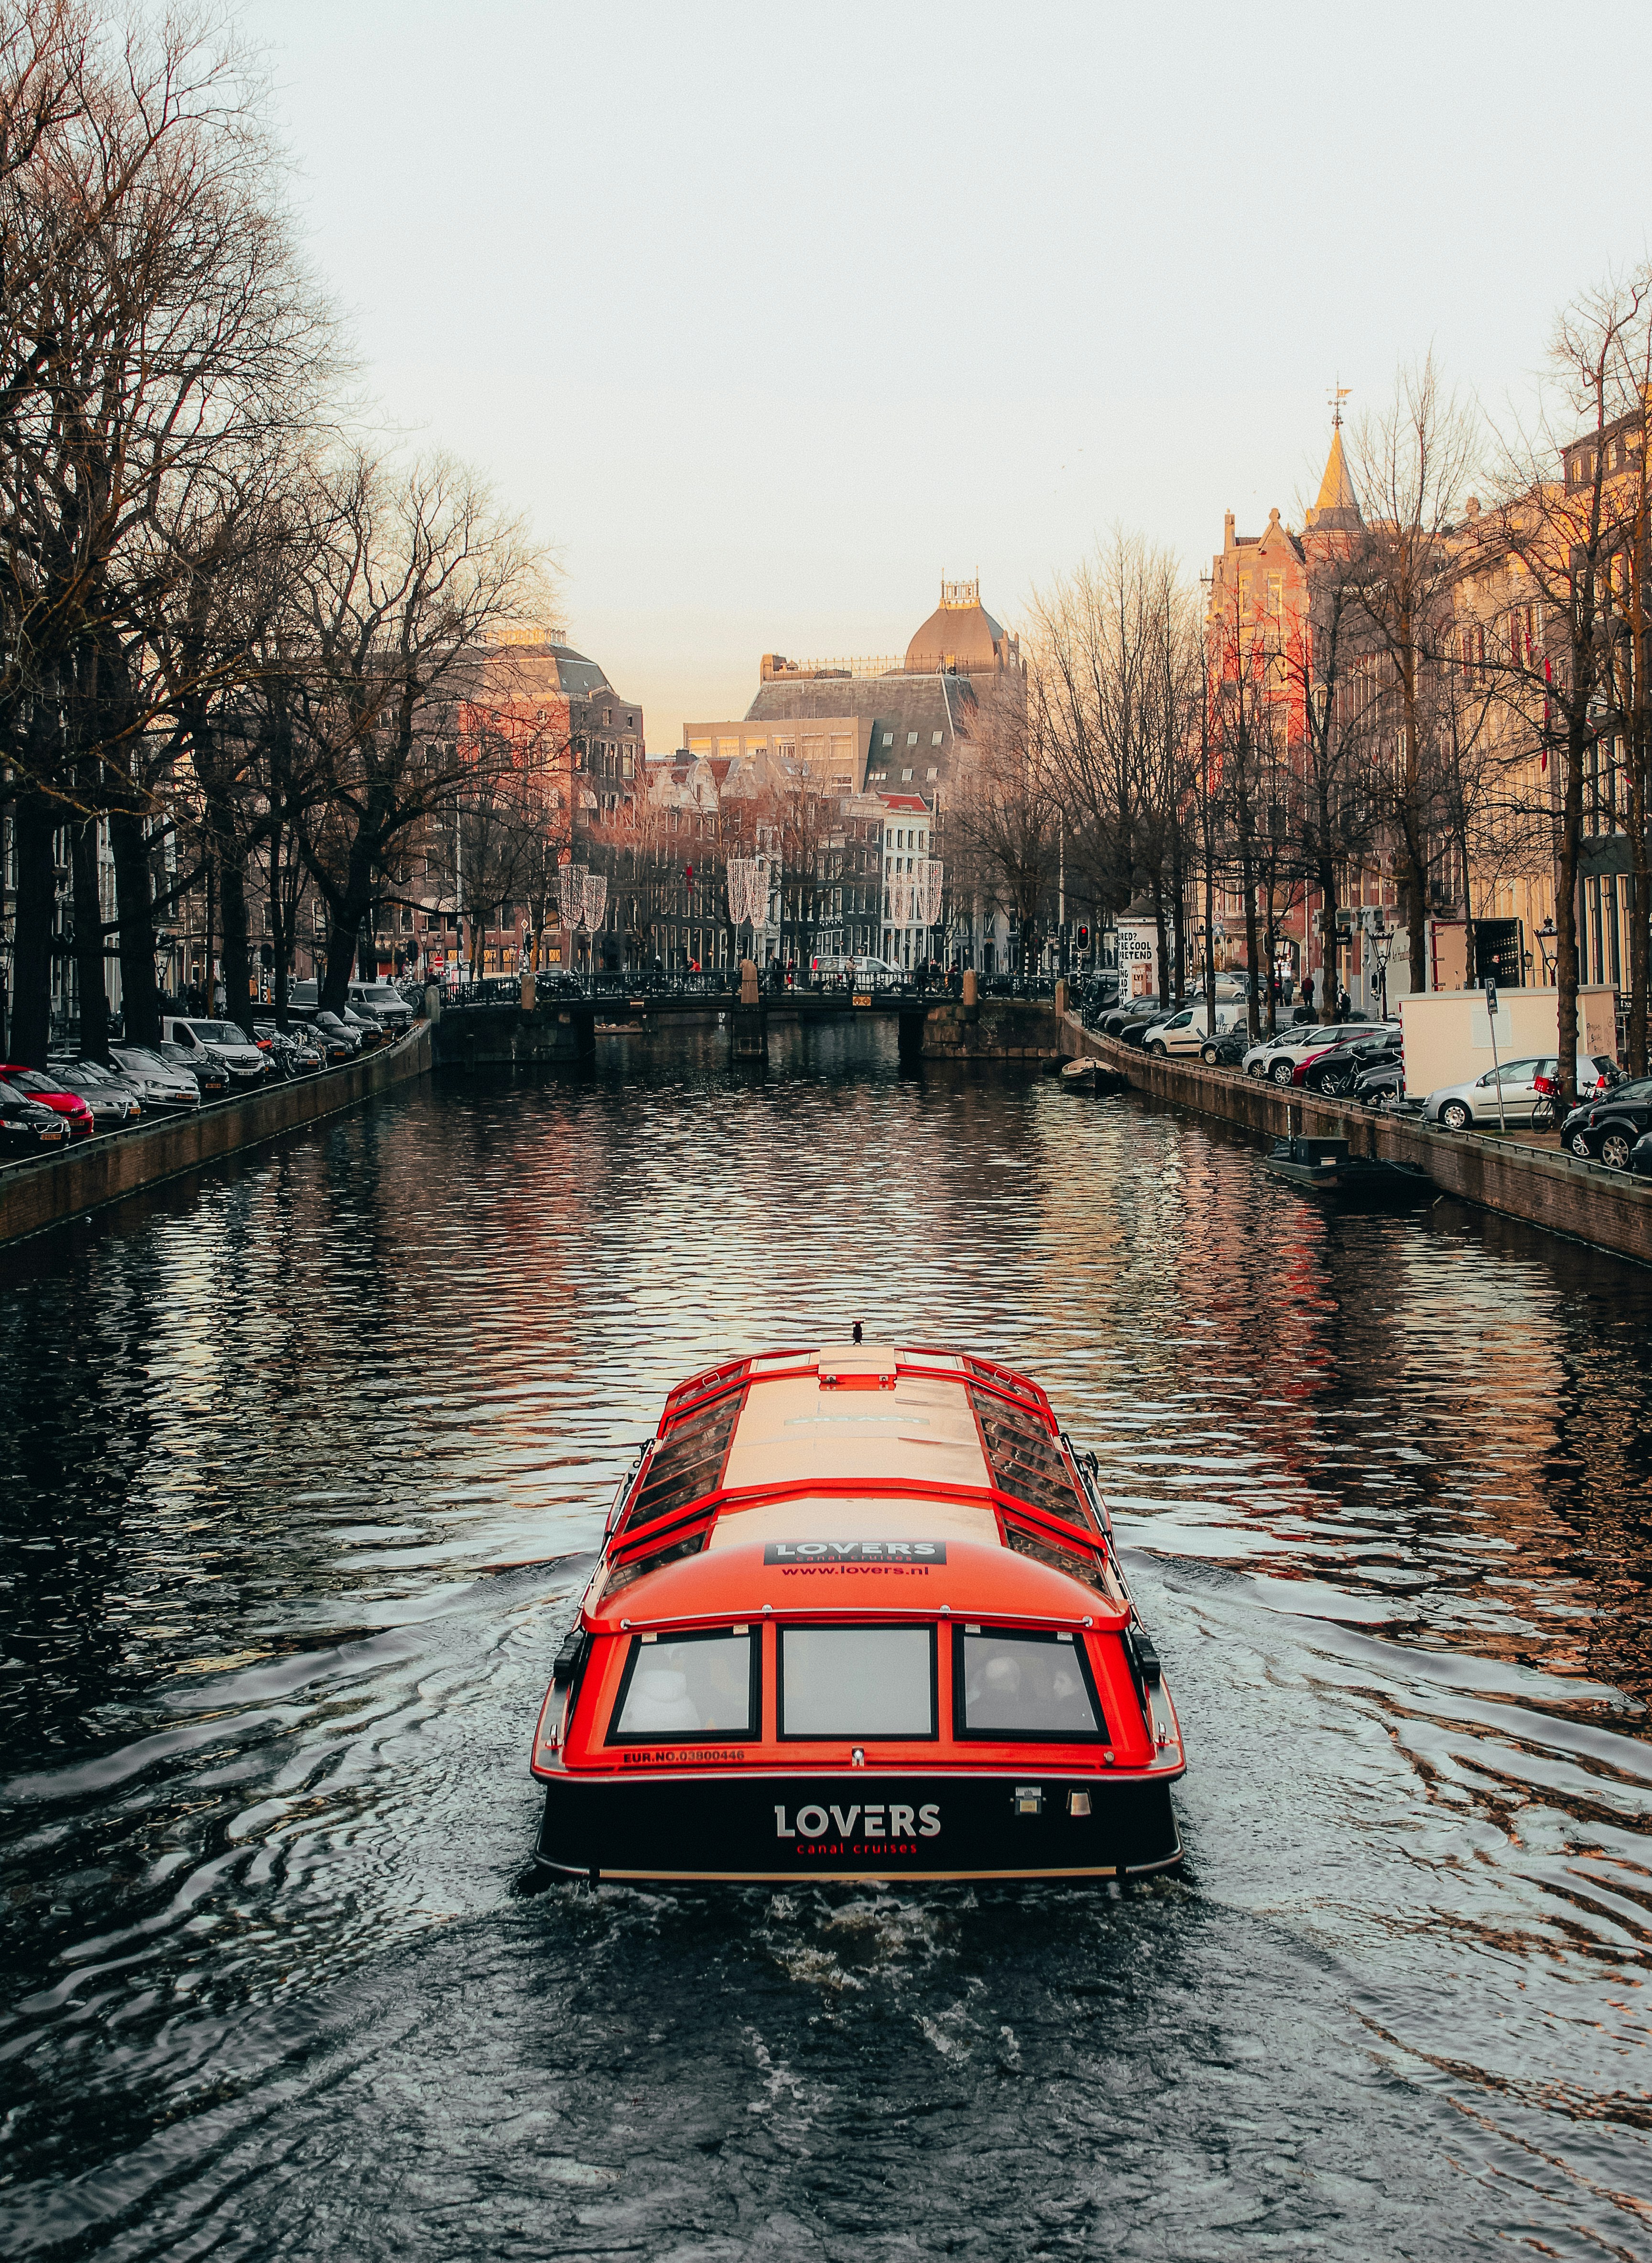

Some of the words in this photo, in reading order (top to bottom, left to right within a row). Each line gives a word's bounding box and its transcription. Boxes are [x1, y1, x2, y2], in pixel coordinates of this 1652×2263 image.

[1130, 942, 1151, 950] COOL
[1119, 951, 1152, 959] PRETEND
[1245, 977, 1249, 986] P
[1488, 981, 1493, 996] P
[776, 1543, 935, 1556] LOVERS
[782, 1566, 929, 1575] www.lovers.nl
[624, 1750, 745, 1763] EUR.NO.03800446
[774, 1804, 941, 1838] LOVERS
[797, 1842, 843, 1854] canal
[853, 1843, 917, 1854] cruises
